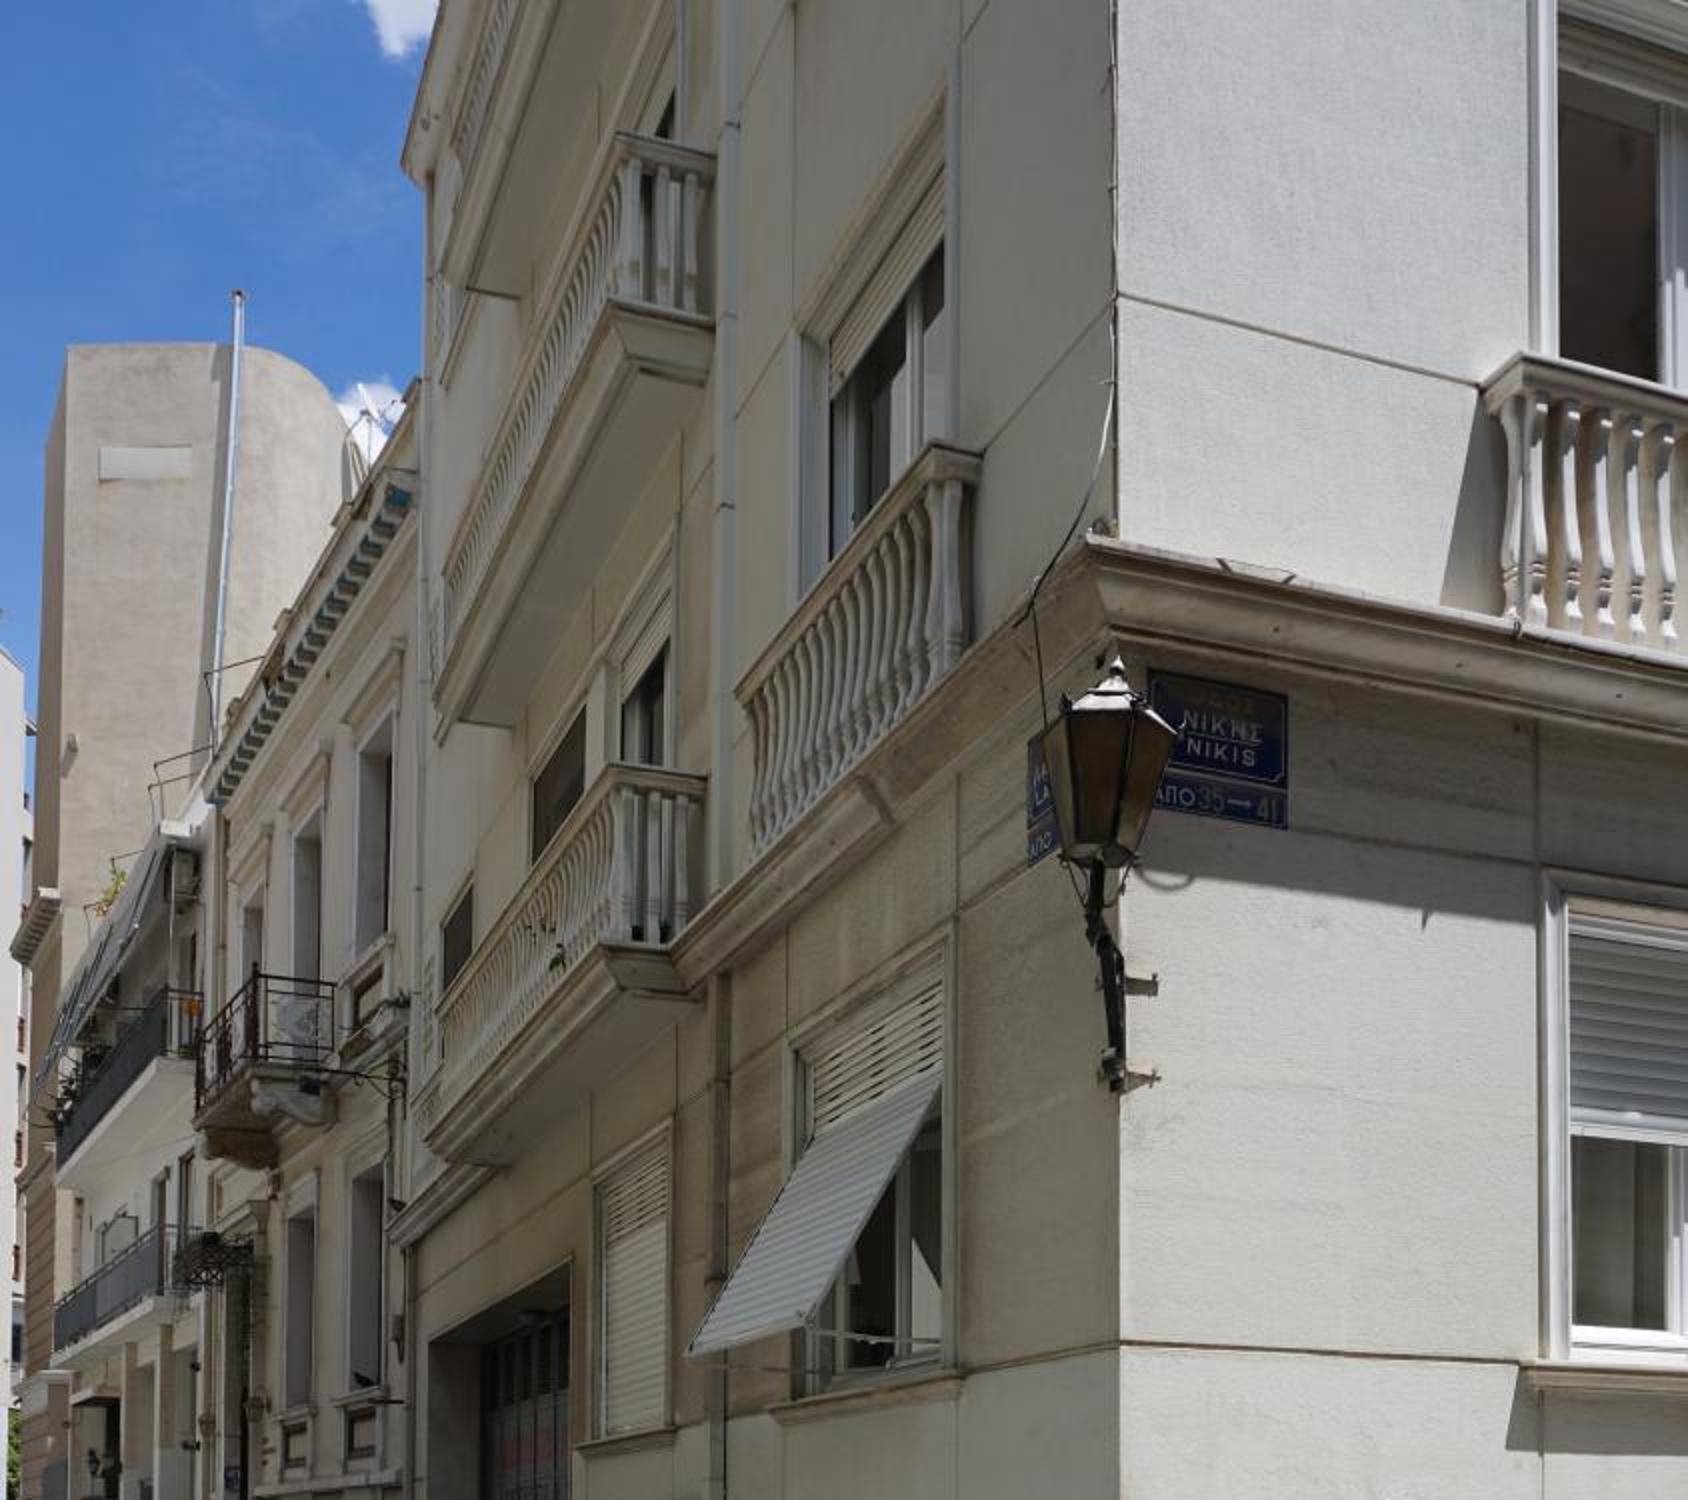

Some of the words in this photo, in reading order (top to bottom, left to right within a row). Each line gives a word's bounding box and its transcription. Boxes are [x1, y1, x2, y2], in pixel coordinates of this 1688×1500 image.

[1183, 708, 1262, 742] ΝΙΚΗΣ
[1186, 738, 1256, 767] NIKIS
[1257, 796, 1278, 821] 41
